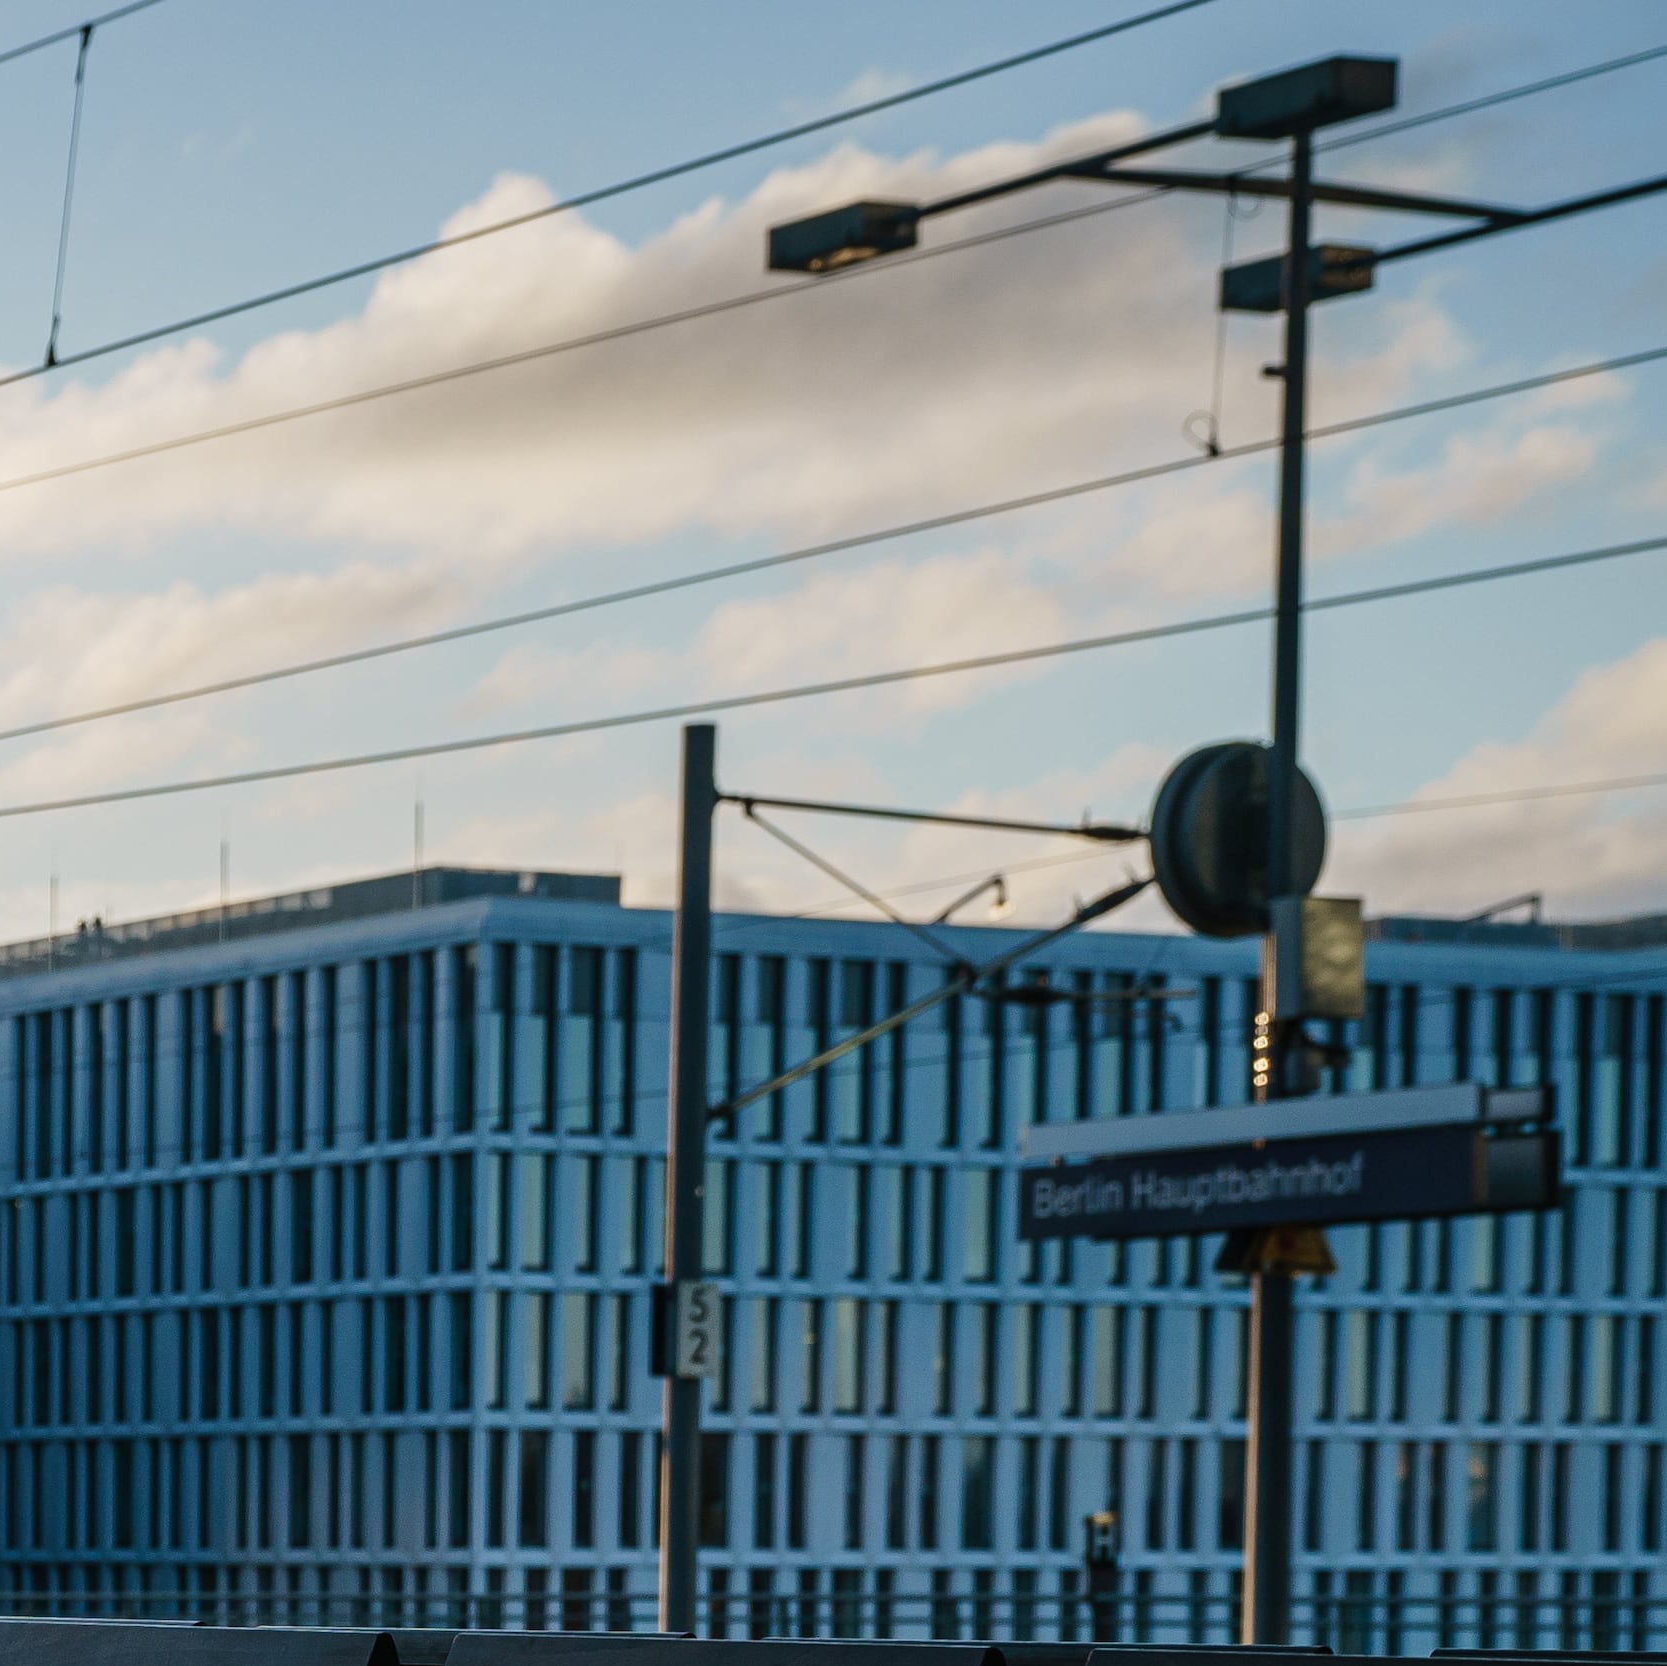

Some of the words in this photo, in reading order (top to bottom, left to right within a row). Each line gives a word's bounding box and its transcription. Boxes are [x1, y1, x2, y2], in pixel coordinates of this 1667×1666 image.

[1033, 1178, 1124, 1219] Berlin
[1129, 1150, 1364, 1215] Hauptbahnhof
[689, 1286, 709, 1323] 5
[689, 1326, 709, 1365] 2
